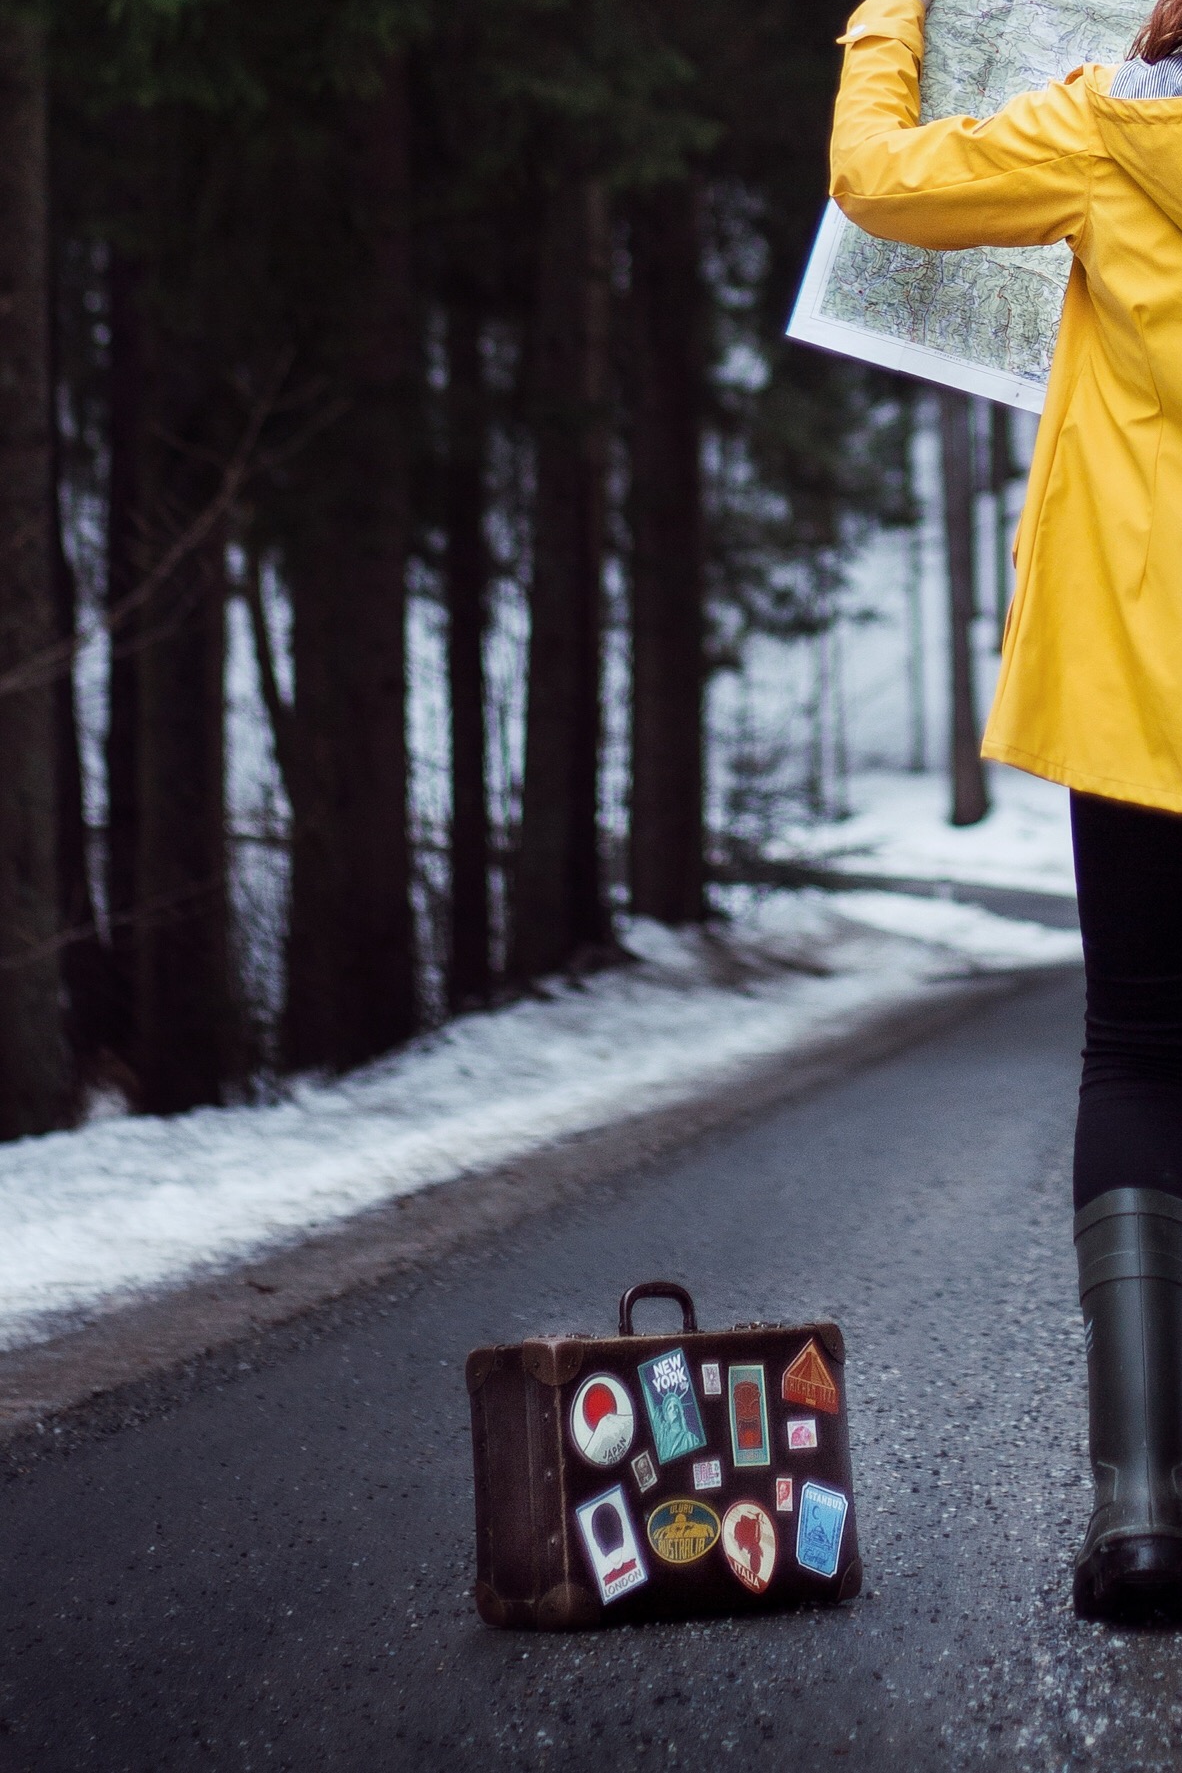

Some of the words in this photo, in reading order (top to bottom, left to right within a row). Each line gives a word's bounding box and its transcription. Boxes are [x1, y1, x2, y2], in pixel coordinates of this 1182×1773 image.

[653, 1353, 681, 1378] NEW
[652, 1366, 687, 1392] YORK
[602, 1436, 627, 1459] JAPAN
[804, 1489, 844, 1511] ISTANBUL
[657, 1537, 706, 1560] AUSTRALIA
[604, 1569, 642, 1598] LONDON
[733, 1561, 760, 1589] ITALIA
